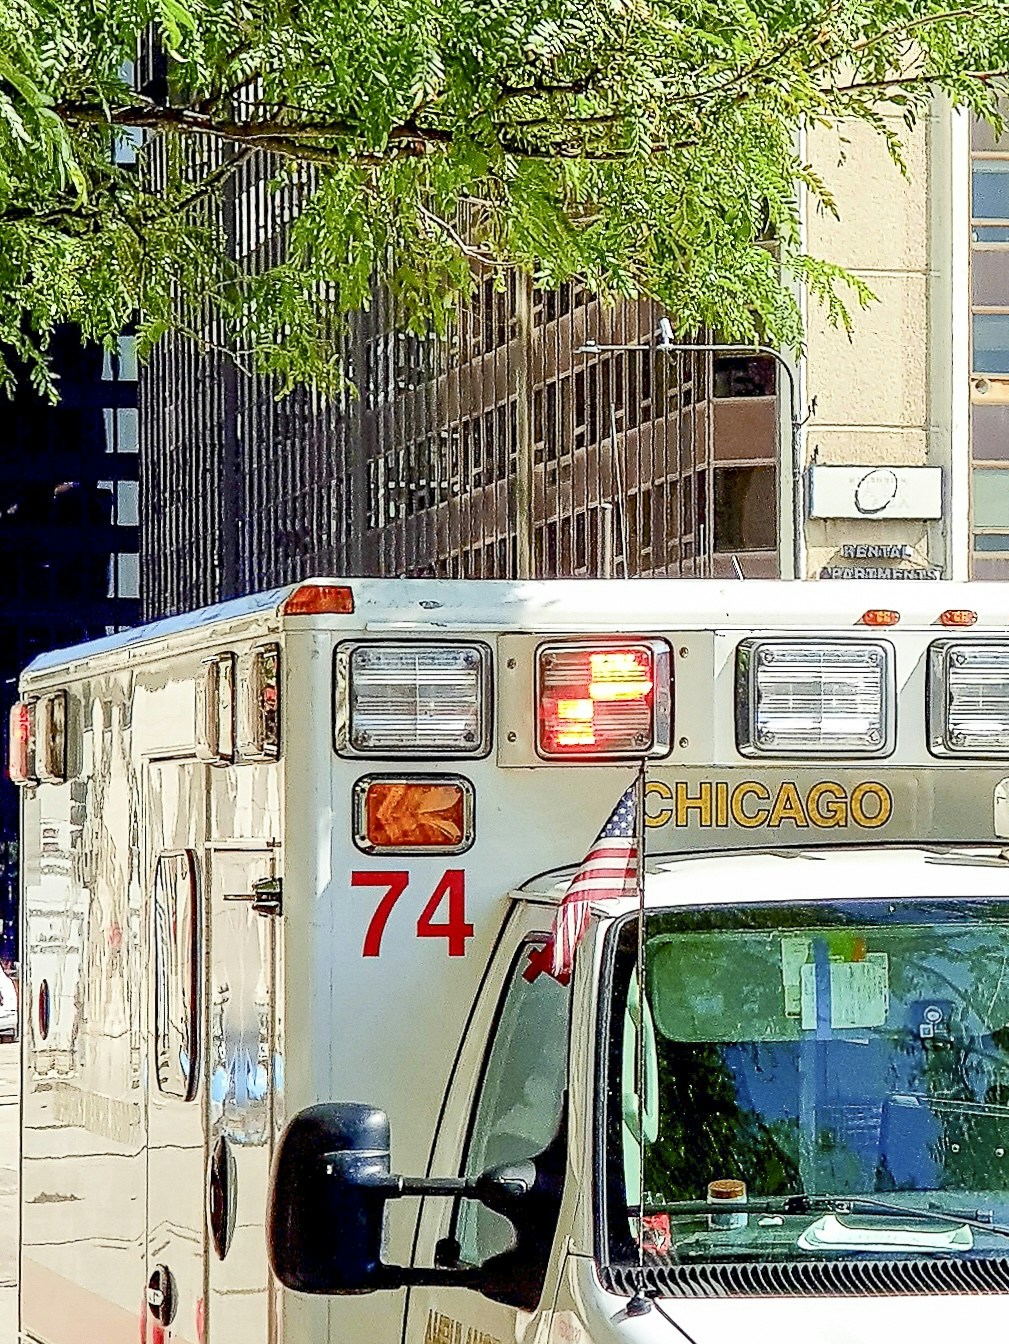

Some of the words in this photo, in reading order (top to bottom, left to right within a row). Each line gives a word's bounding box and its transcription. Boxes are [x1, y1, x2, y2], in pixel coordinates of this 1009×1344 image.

[843, 545, 914, 558] RENTAL
[642, 781, 893, 828] CHICAGO
[351, 869, 474, 958] 74
